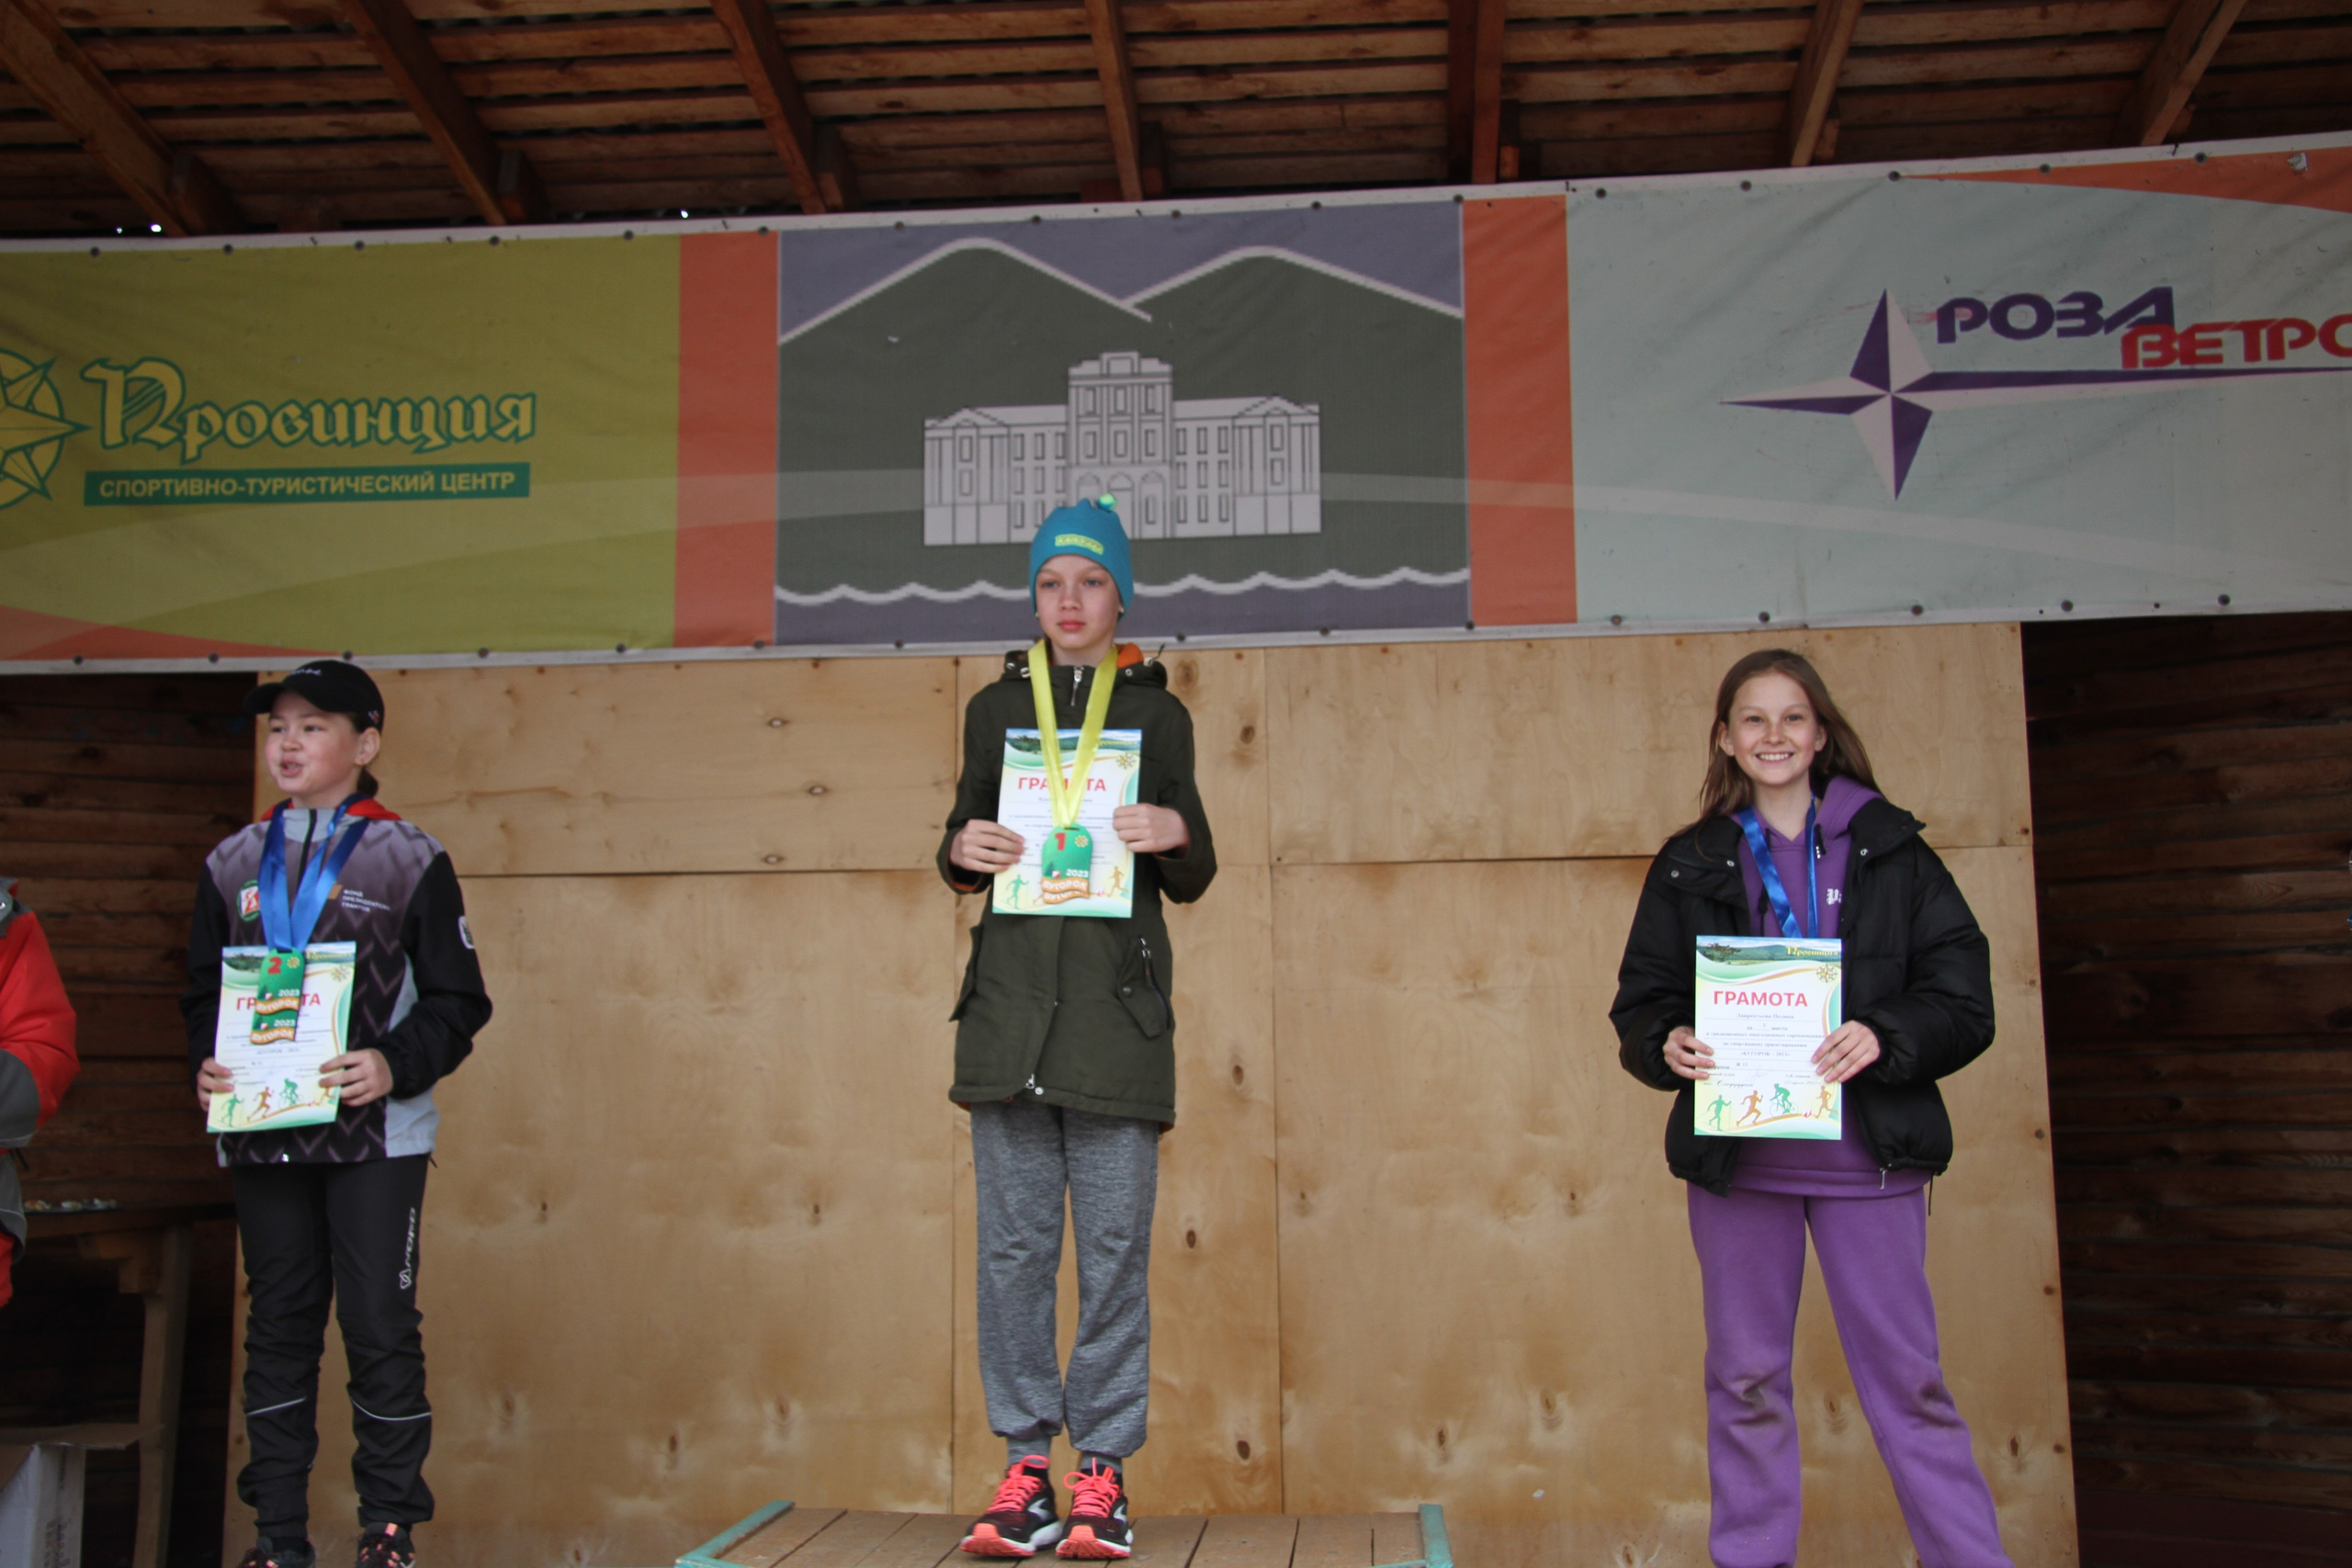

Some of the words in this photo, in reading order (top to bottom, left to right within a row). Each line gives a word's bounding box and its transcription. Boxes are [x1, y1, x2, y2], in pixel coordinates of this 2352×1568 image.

[1937, 286, 2176, 344] РОЗА
[80, 356, 537, 465] Провинция
[99, 470, 435, 499] СПОРТИВНО-ТУРИСТИЧЕСКИЙ
[441, 470, 515, 494] ЦЕНТР
[1018, 777, 1106, 792] ГРАТА
[1055, 832, 1067, 851] 1
[1066, 868, 1089, 878] 2023
[267, 956, 282, 975] 2
[236, 993, 322, 1011] ГРТА
[277, 988, 300, 998] 2023
[1713, 990, 1808, 1008] ГРАМОТА
[273, 1019, 296, 1027] 2023
